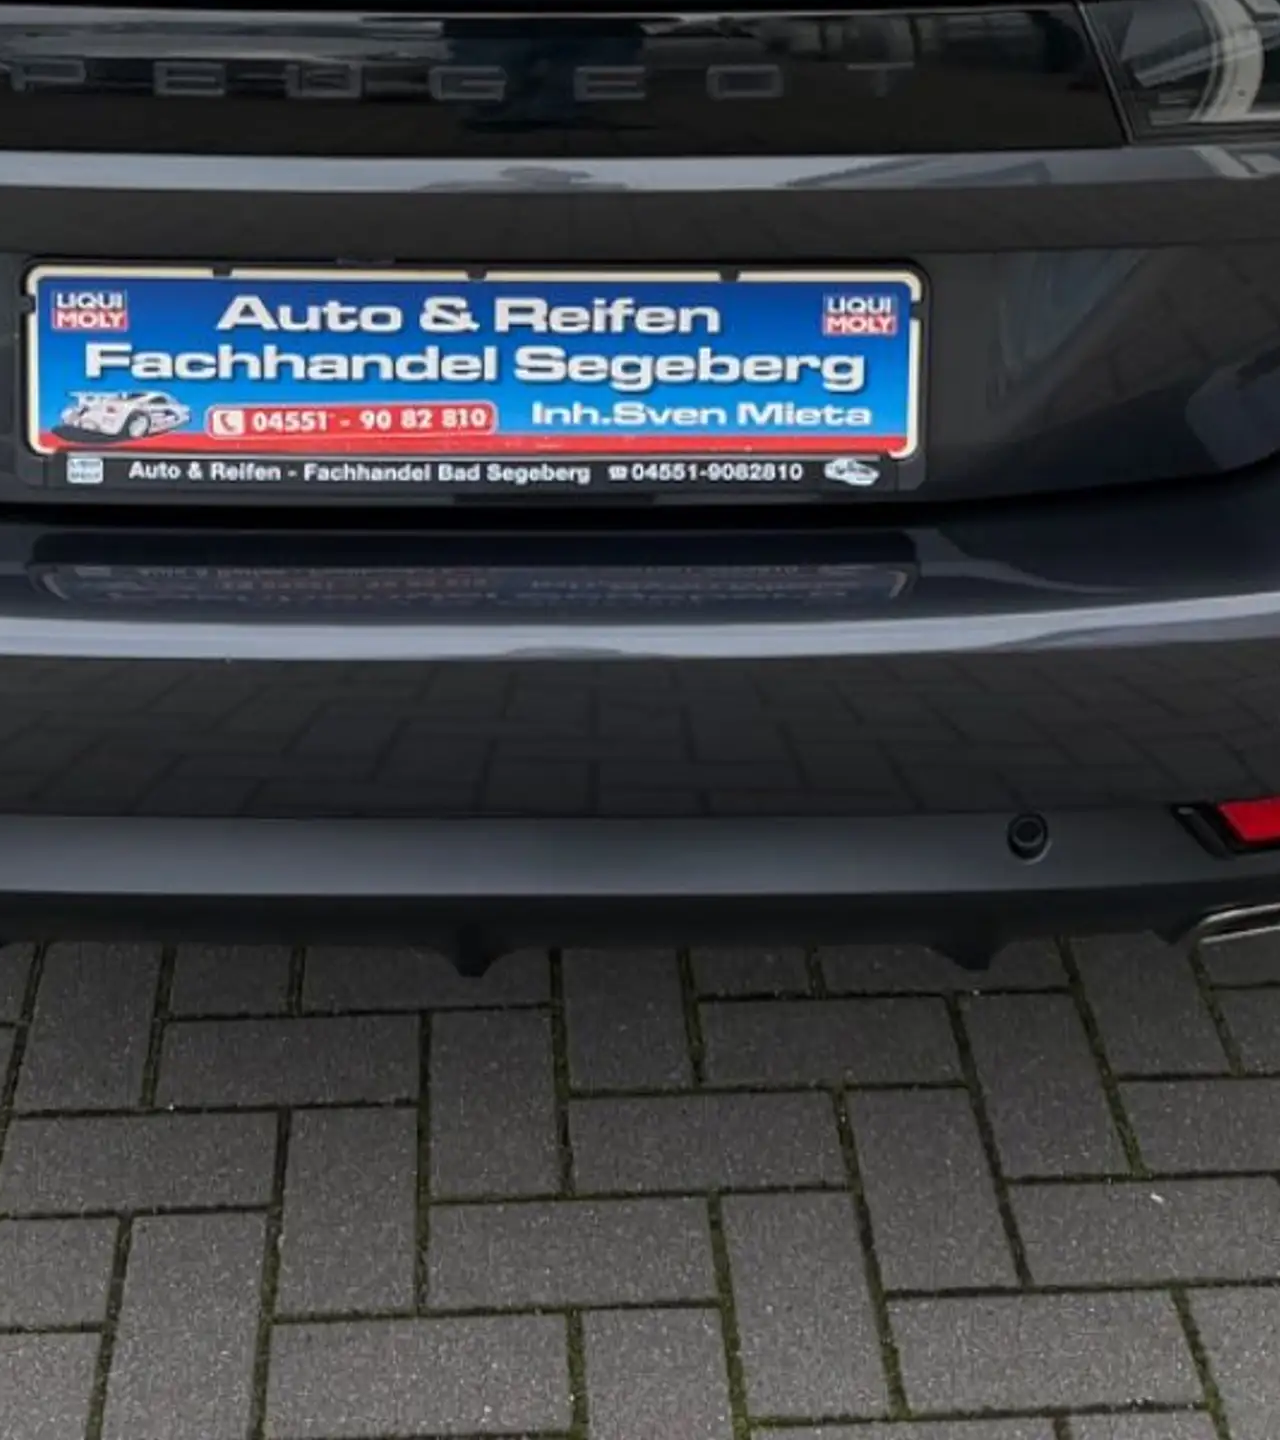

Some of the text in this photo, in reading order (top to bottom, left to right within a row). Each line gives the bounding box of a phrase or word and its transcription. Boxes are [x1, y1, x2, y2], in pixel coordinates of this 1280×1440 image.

[12, 56, 914, 100] PEUGEOT
[56, 290, 124, 309] LIQUI
[825, 296, 892, 315] LIQUI
[56, 310, 126, 329] MOLY
[217, 294, 721, 334] Auto & Reifen
[825, 315, 894, 335] MOLY
[84, 342, 866, 391] Fachhandel Segeberg
[251, 411, 329, 432] 04551
[359, 410, 392, 431] 90
[401, 409, 433, 430] 82
[443, 408, 488, 429] 810
[531, 401, 728, 426] Inh.Sven
[128, 461, 181, 480] Auto
[188, 462, 203, 480] &
[212, 461, 282, 481] Reifen
[303, 462, 430, 482] Fachhandel
[438, 463, 480, 482] Bad
[486, 463, 590, 484] Segeberg
